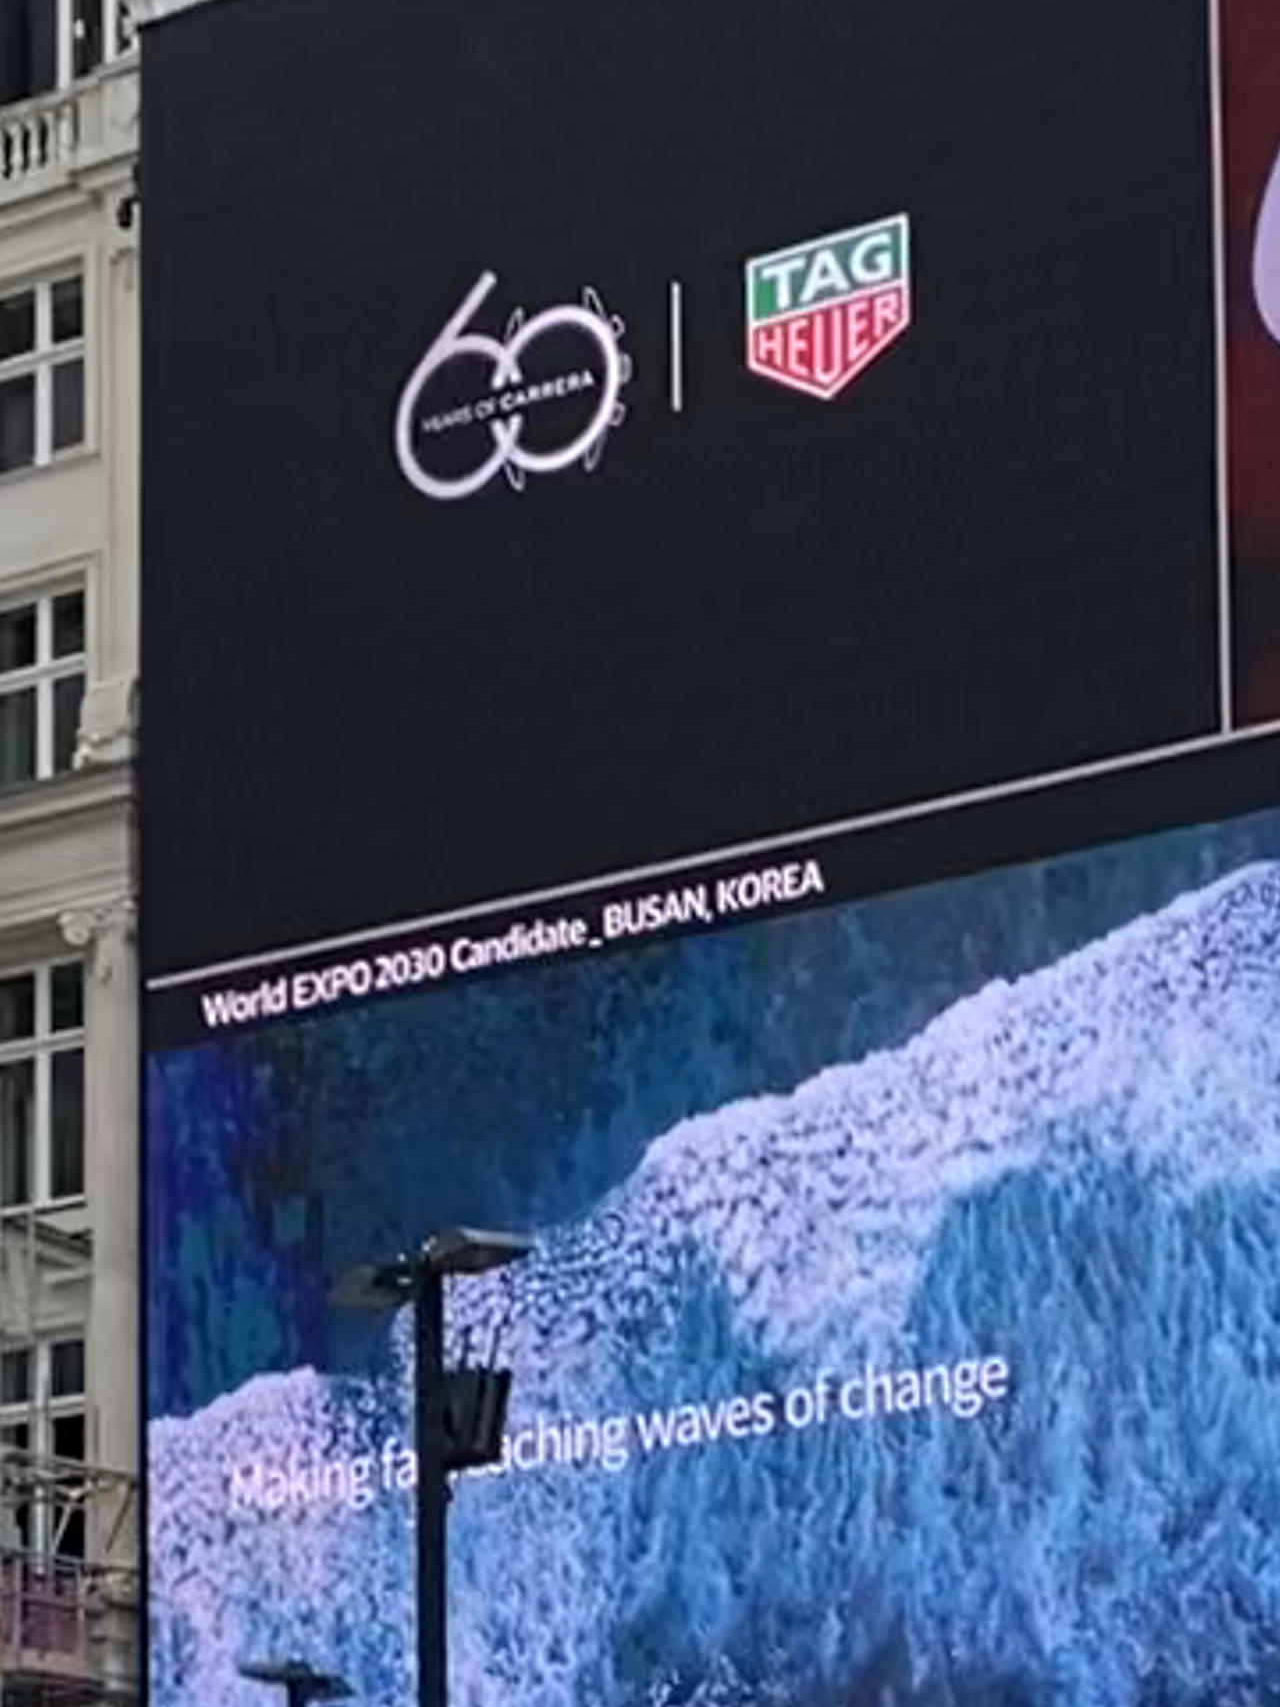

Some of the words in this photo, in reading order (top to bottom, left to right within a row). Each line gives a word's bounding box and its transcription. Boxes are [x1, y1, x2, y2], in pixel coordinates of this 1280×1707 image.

[761, 233, 893, 311] TAG
[396, 269, 621, 499] 60
[757, 292, 899, 385] HEUER
[422, 405, 473, 433] YEARS
[475, 397, 497, 420] OF
[499, 370, 596, 411] CARRERA
[201, 981, 288, 1028] World
[291, 962, 370, 1011] EXPO
[374, 943, 446, 990] 2030
[717, 860, 825, 914] KOREA
[228, 1447, 374, 1511] Making
[635, 1390, 776, 1453] waves
[784, 1368, 838, 1429] of
[839, 1355, 1010, 1419] change
